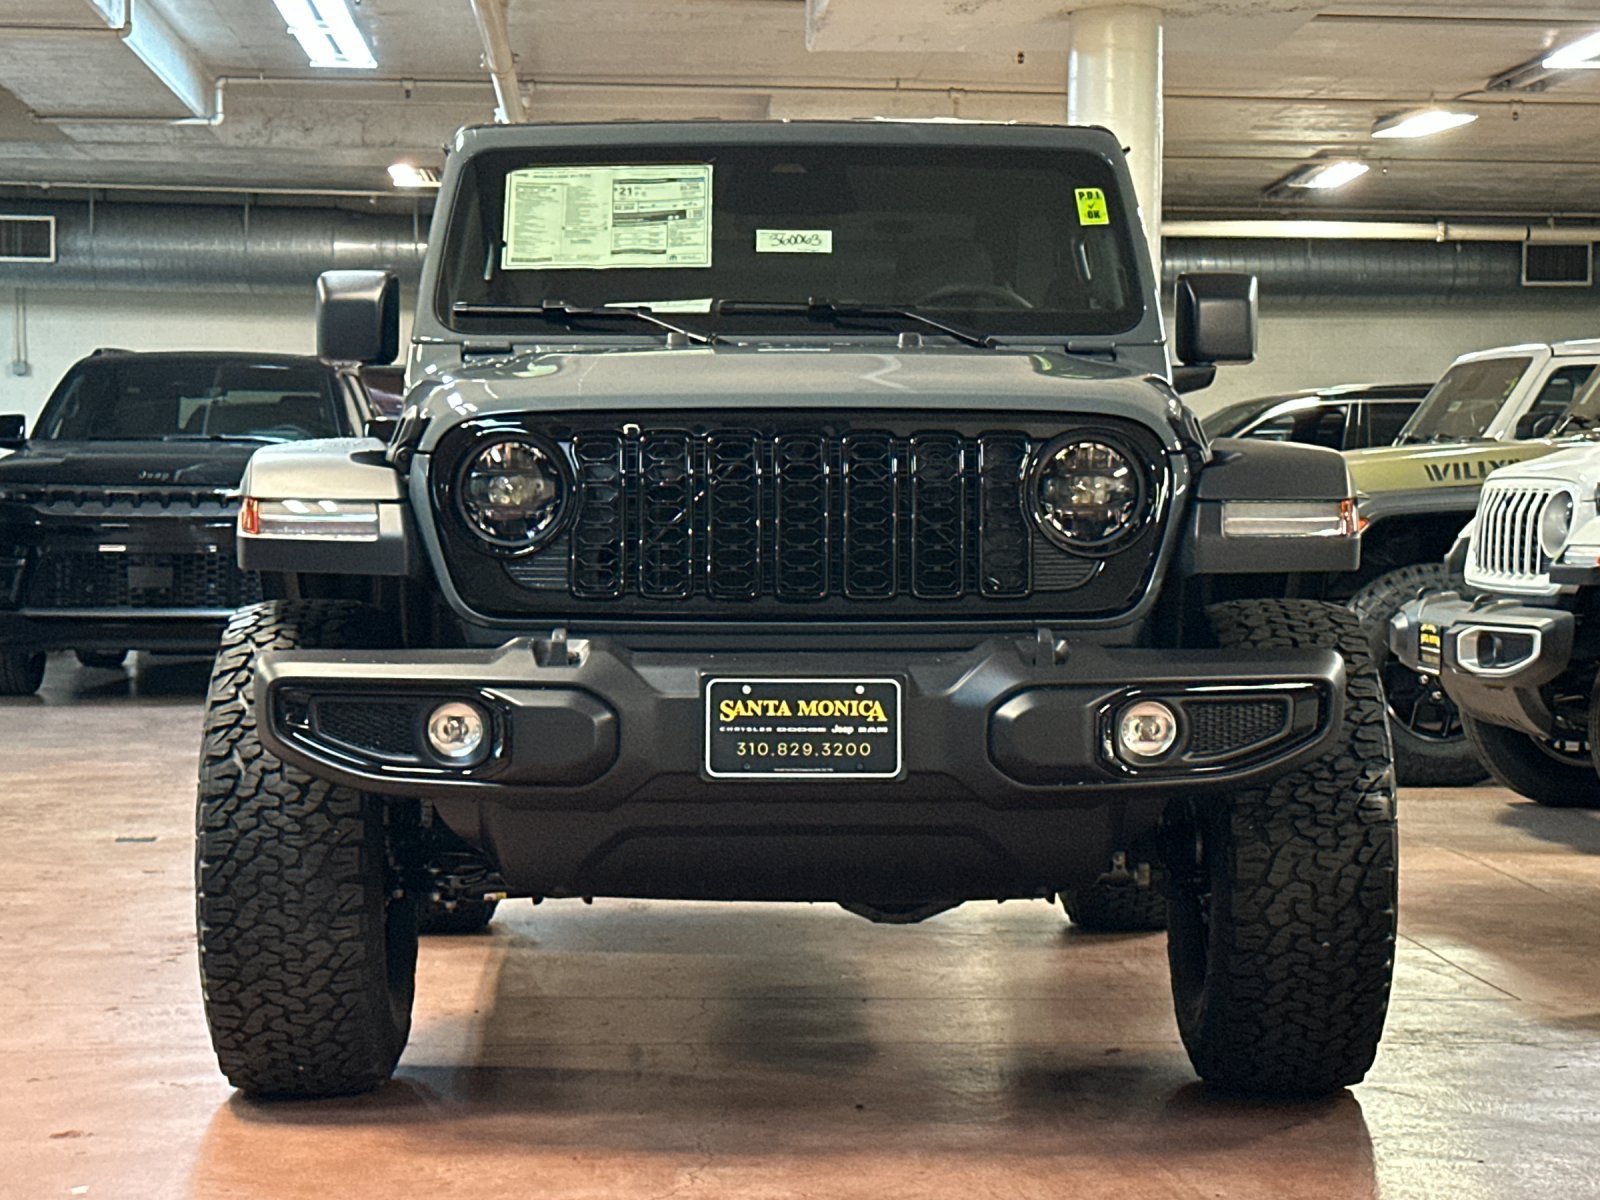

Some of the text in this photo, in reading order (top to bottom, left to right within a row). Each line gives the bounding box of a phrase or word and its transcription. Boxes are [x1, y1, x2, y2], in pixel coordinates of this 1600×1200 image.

[620, 187, 632, 196] 21
[138, 470, 169, 480] Jeep
[719, 700, 888, 722] SANTA MONICA
[831, 724, 854, 735] Jeep
[737, 742, 871, 756] 310.829.3200
